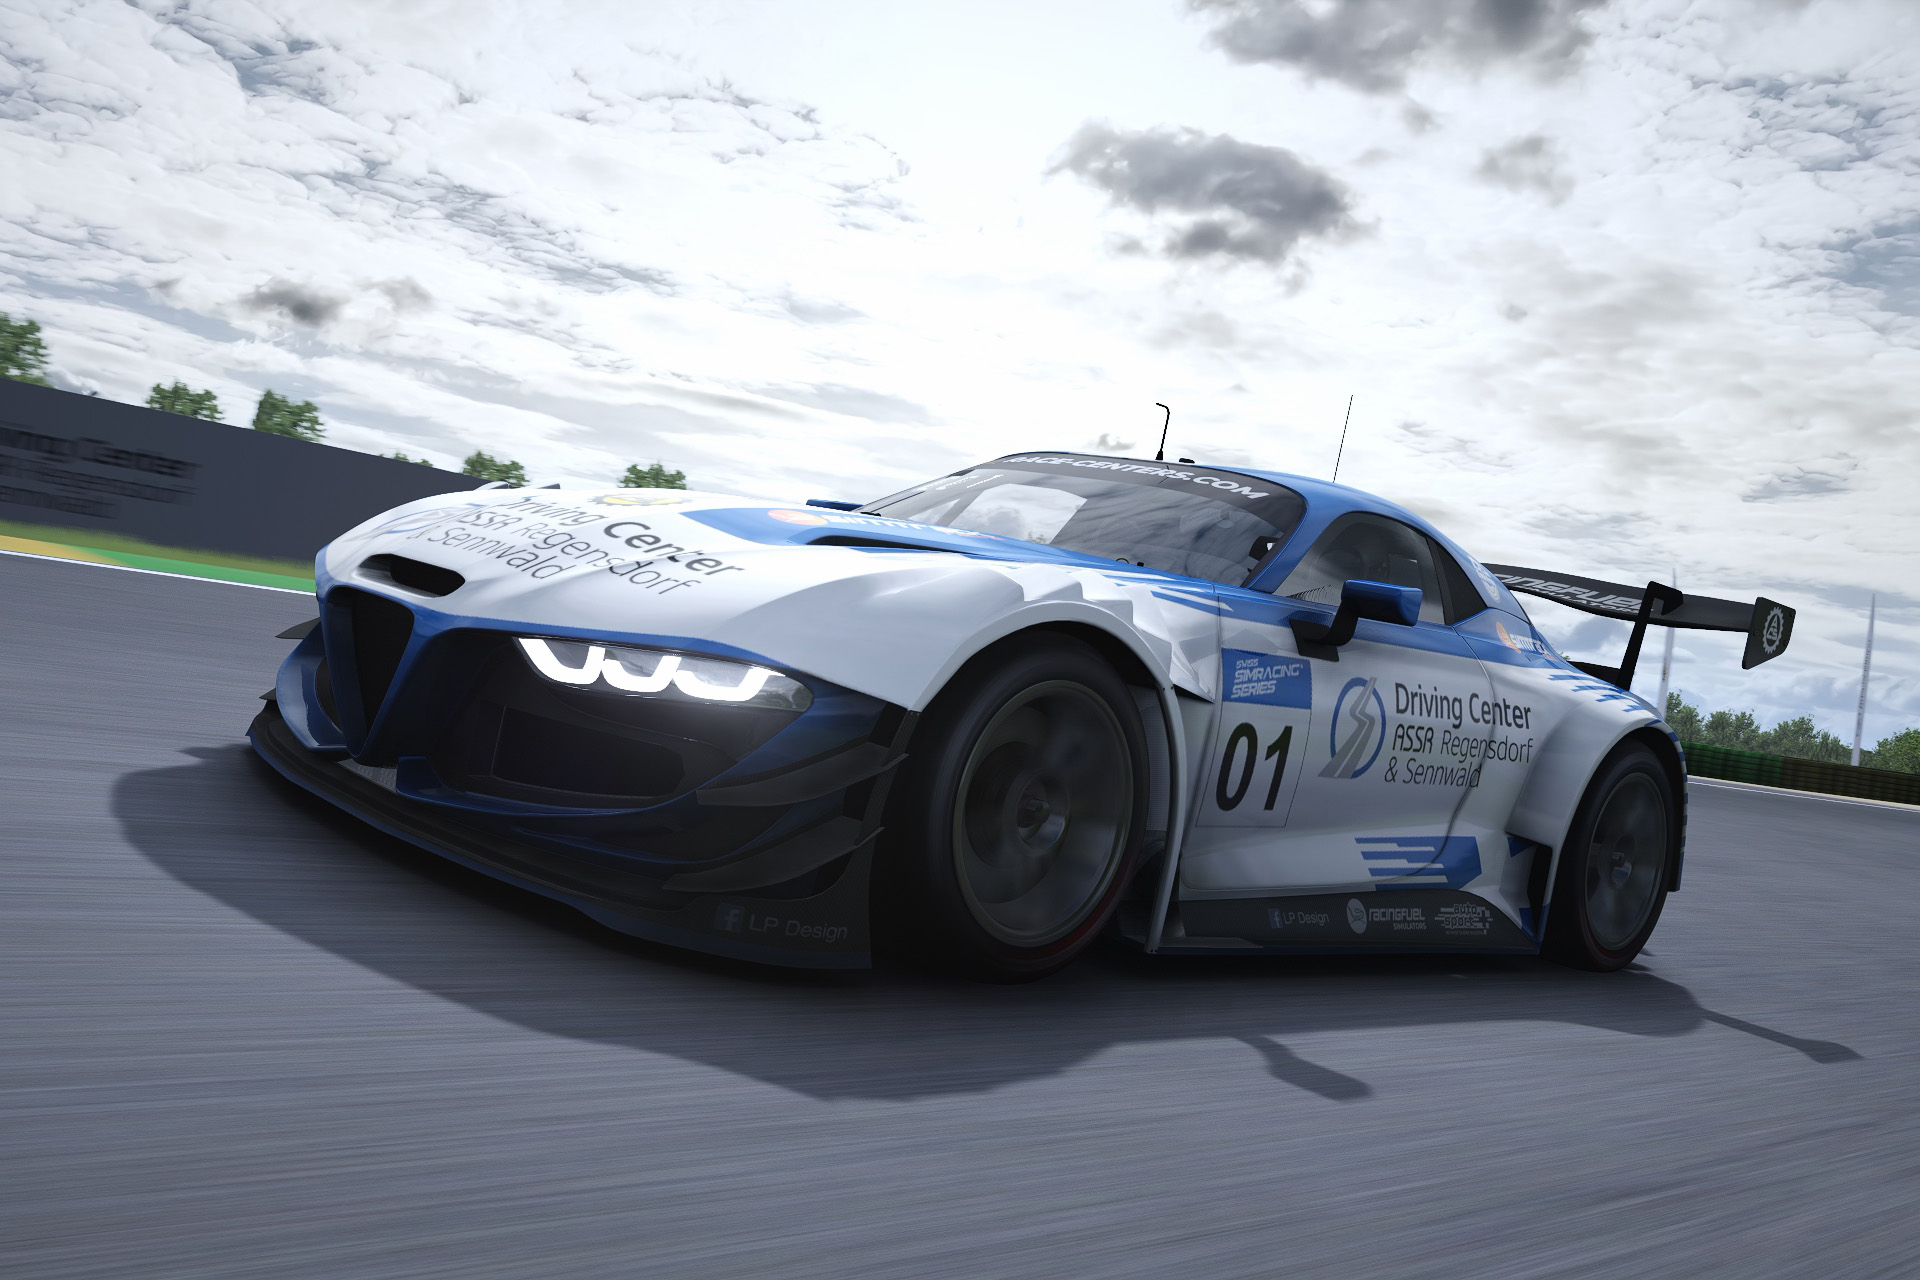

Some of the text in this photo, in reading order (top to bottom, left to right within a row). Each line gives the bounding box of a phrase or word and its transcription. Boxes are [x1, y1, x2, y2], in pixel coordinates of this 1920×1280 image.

[427, 527, 577, 580] Sennwald
[511, 522, 702, 595] Regensdorf
[604, 520, 746, 577] Center
[1231, 680, 1277, 698] SERIES
[1395, 682, 1531, 730] Driving Center
[1440, 730, 1534, 764] Regensdorf
[1216, 722, 1293, 812] 01
[1384, 756, 1482, 788] & Sennwald
[1282, 911, 1296, 925] LP
[1298, 911, 1330, 926] Design
[1444, 915, 1474, 928] sport
[1453, 903, 1478, 915] auto
[748, 913, 779, 932] LP
[785, 919, 848, 943] Design
[1393, 922, 1427, 931] SIMULATORS
